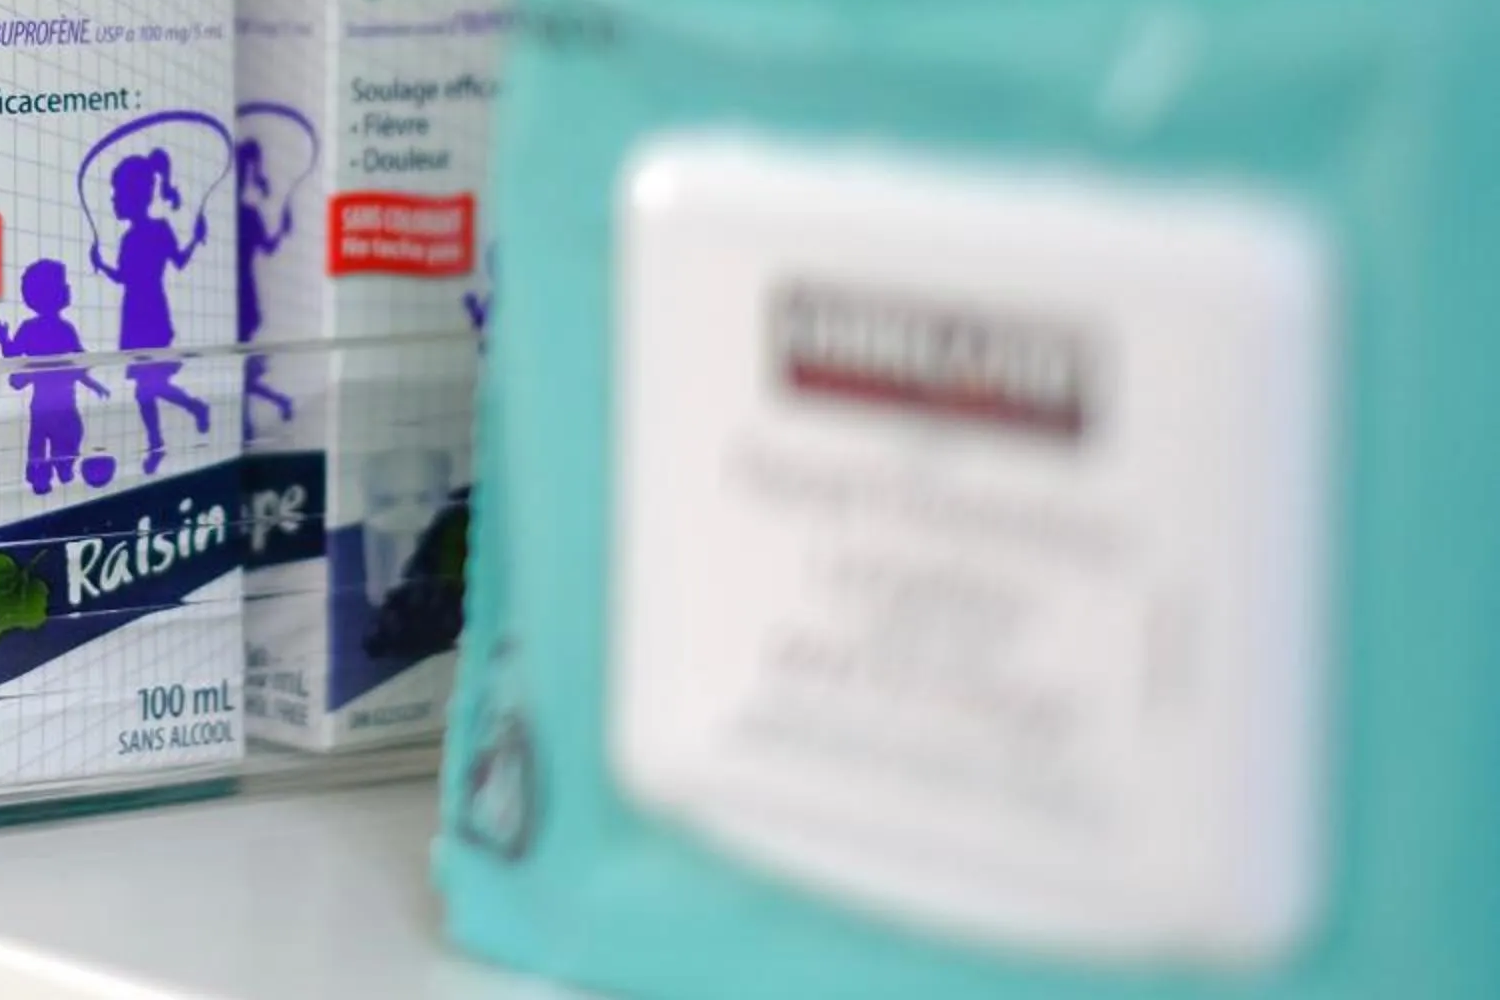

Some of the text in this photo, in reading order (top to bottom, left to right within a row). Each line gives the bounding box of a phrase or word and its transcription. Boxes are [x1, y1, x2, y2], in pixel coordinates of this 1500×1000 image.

[352, 76, 439, 106] Soulage
[363, 112, 431, 137] Fièvre
[363, 149, 450, 173] Douleur
[65, 498, 228, 606] Raisin
[138, 683, 185, 721] 100
[193, 678, 236, 715] mL
[118, 720, 235, 755] SANS ALCOOL
